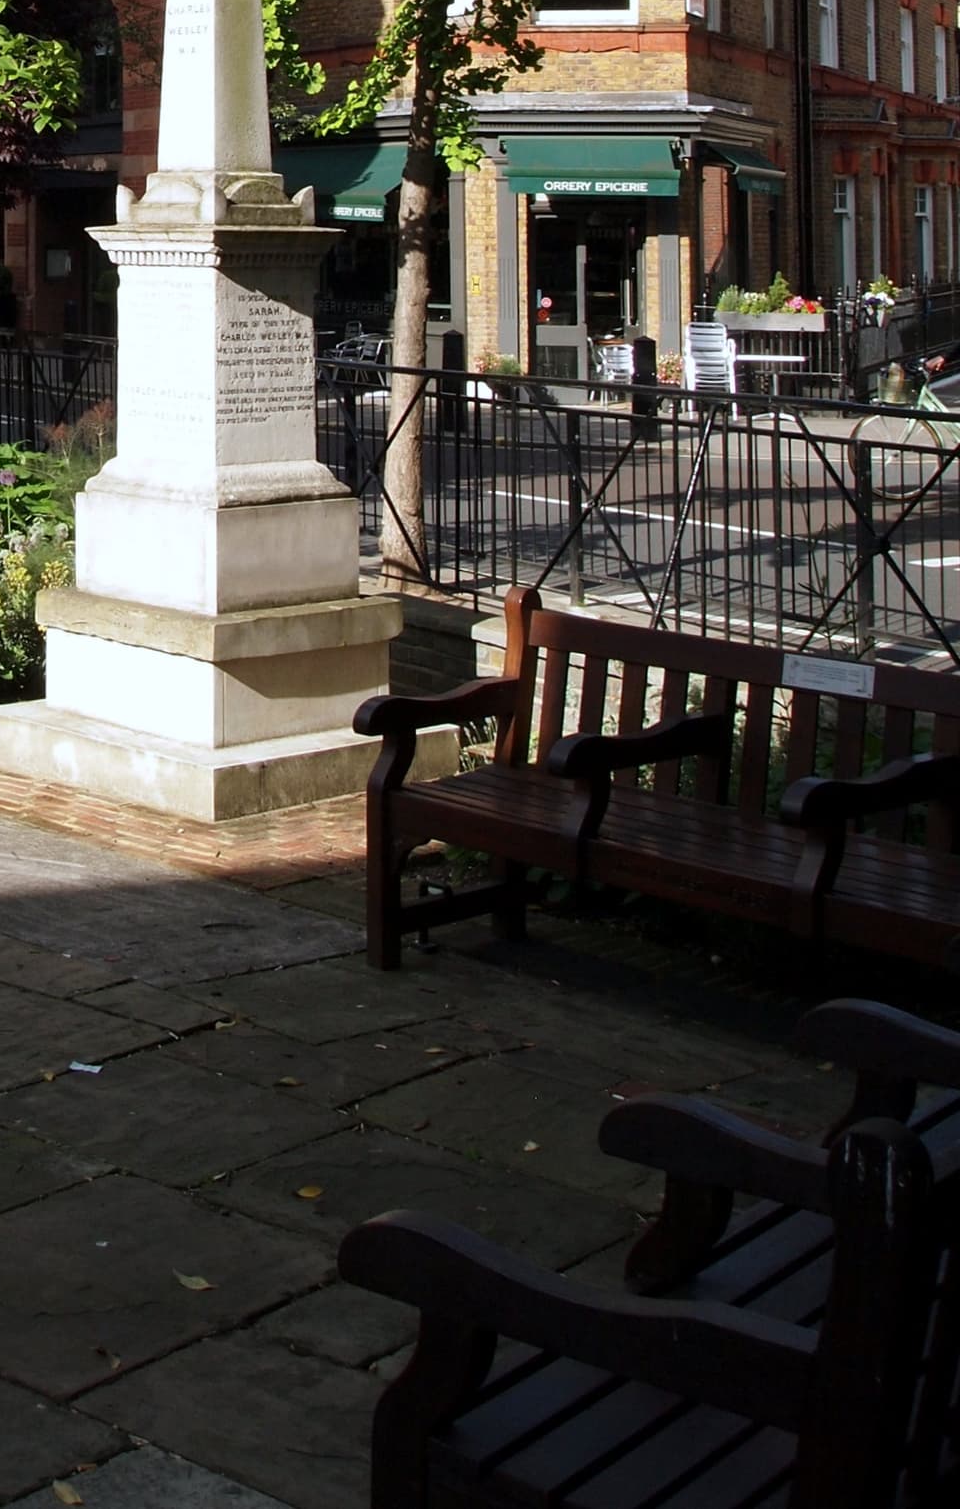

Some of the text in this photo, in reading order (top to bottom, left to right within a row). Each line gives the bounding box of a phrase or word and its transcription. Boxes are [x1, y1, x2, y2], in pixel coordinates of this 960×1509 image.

[169, 24, 208, 36] WESLEY
[544, 181, 648, 192] ORRERY EPICERIE
